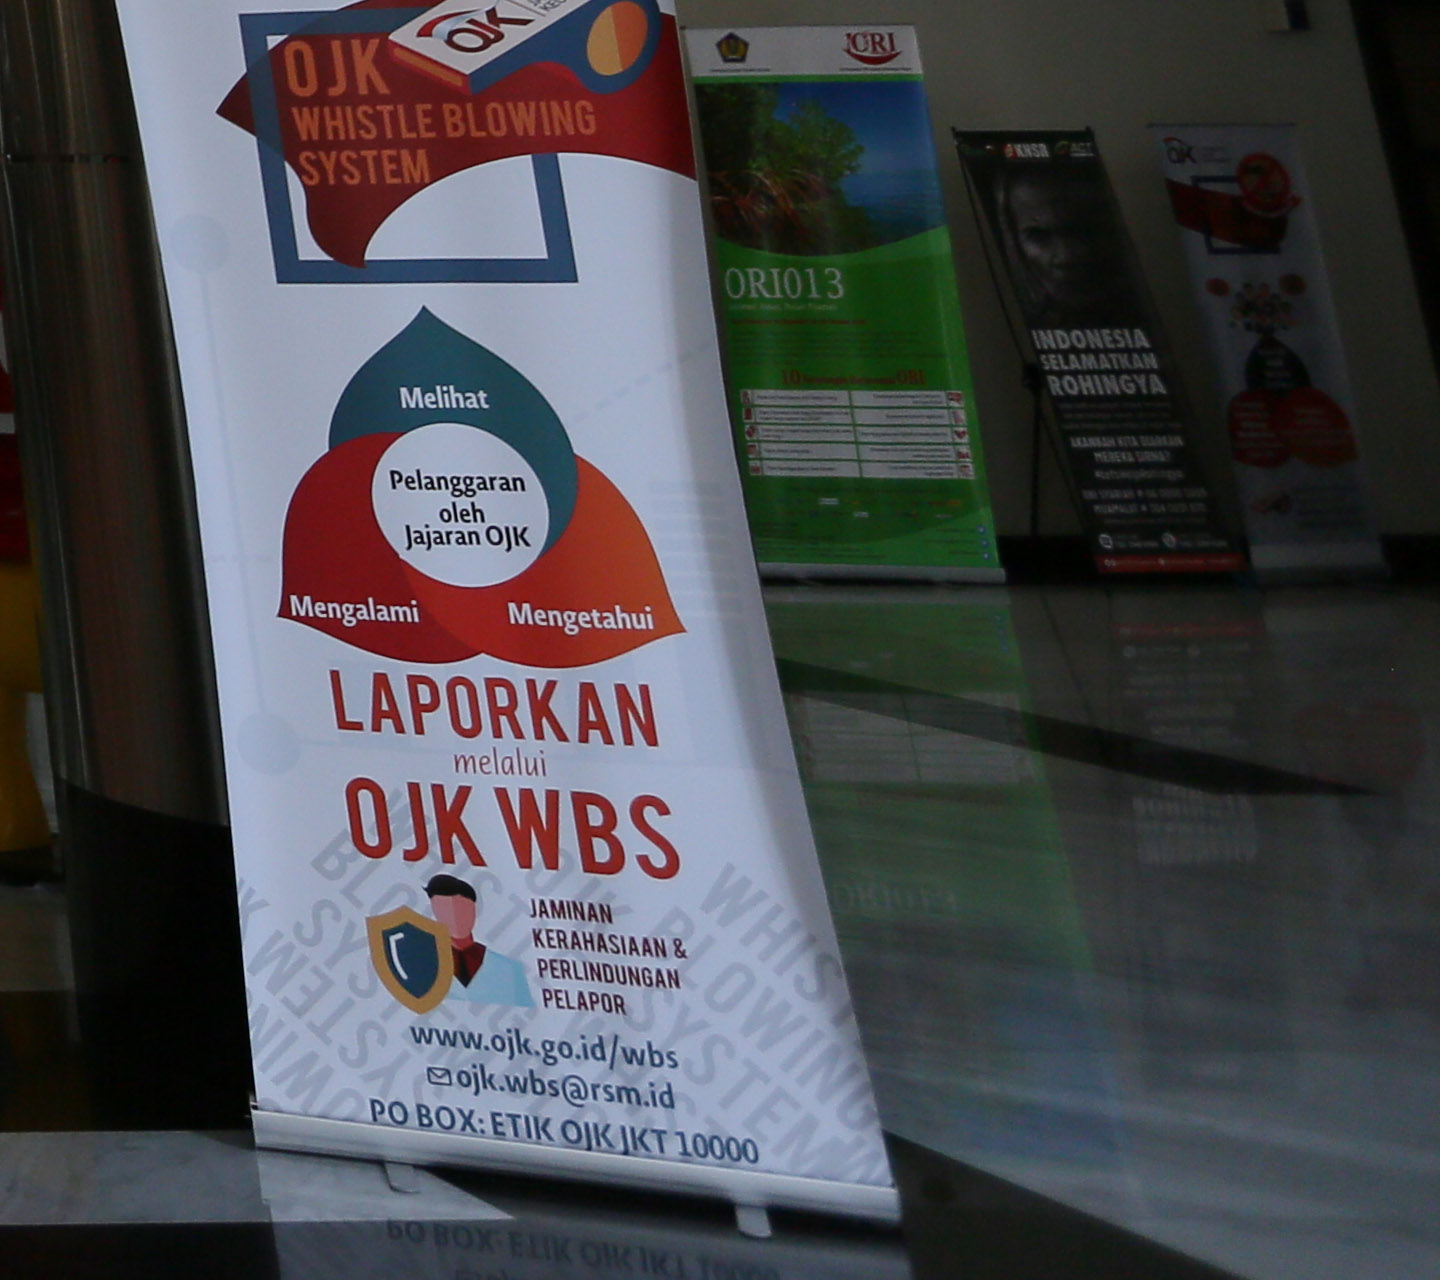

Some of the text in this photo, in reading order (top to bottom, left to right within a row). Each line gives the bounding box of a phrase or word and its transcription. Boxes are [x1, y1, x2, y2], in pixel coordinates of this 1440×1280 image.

[444, 6, 535, 53] OJK
[284, 39, 391, 97] OJK
[291, 100, 597, 141] WHISTLE BLOWING
[298, 148, 430, 186] SYSTEM
[725, 267, 845, 300] ORI013
[1031, 328, 1152, 350] INDONESIA
[1039, 352, 1158, 371] SELAMATKAN
[399, 385, 490, 409] Melihat
[1046, 374, 1167, 396] ROHINGYA
[389, 469, 526, 498] Pelanggaran
[439, 501, 485, 524] oleh
[405, 524, 531, 553] Jajaran OJK
[289, 594, 654, 635] Mengalami Mengetahui
[329, 669, 659, 748] LAPORKAN
[454, 746, 547, 777] melalui
[344, 776, 681, 880] OJK WBS
[530, 898, 613, 924] JAMINAN
[532, 928, 688, 959] KERAHASIAAN &
[537, 958, 681, 990] PERLINDUNGAN
[542, 988, 627, 1016] PELAPOR
[409, 1025, 679, 1070] www.ojk.go.id/wbs
[457, 1064, 676, 1110] ojk.wbs@rsm.id
[369, 1098, 759, 1165] PO BOX: ETIK OJK JKT 10000
